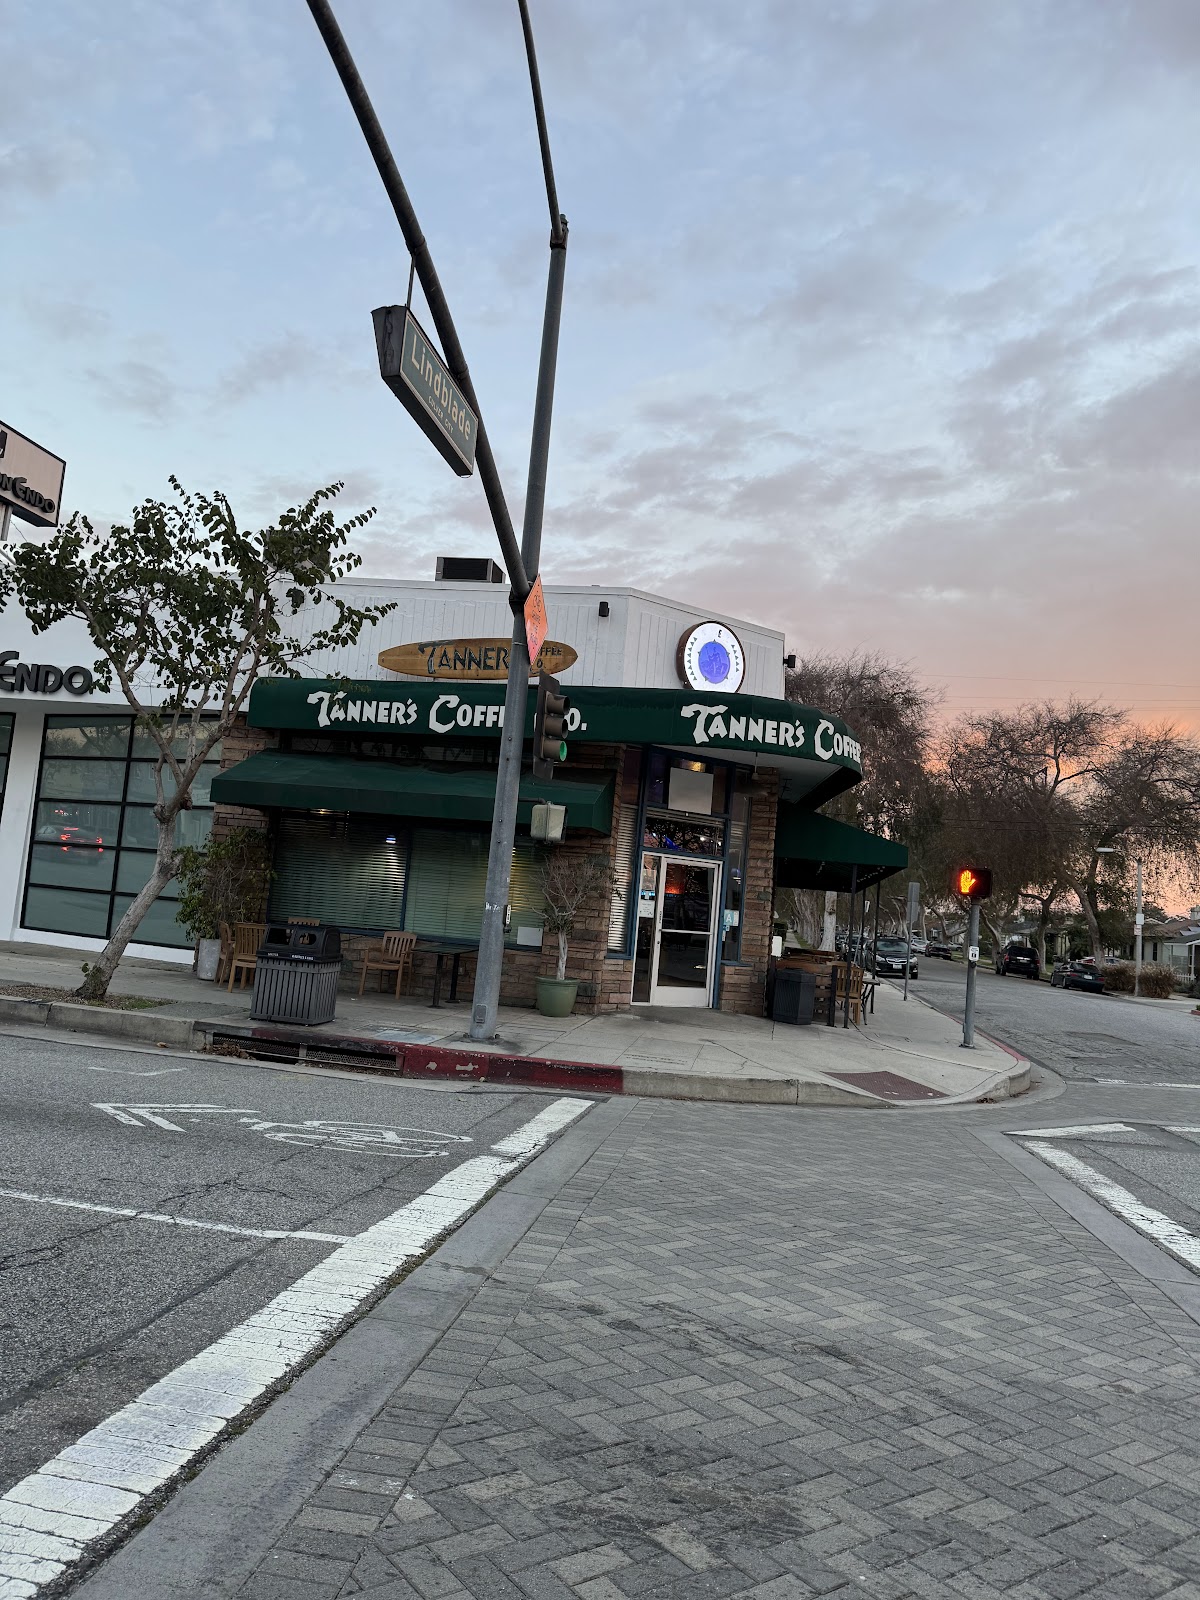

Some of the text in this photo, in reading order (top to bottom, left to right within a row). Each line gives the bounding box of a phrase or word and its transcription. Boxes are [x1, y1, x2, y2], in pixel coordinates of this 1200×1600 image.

[411, 334, 471, 441] Lindblade
[0, 472, 55, 513] NENDO
[0, 650, 93, 694] ENDO
[418, 639, 509, 675] TANNER
[307, 690, 418, 728] TANNER'S
[680, 703, 805, 748] TANNER'S
